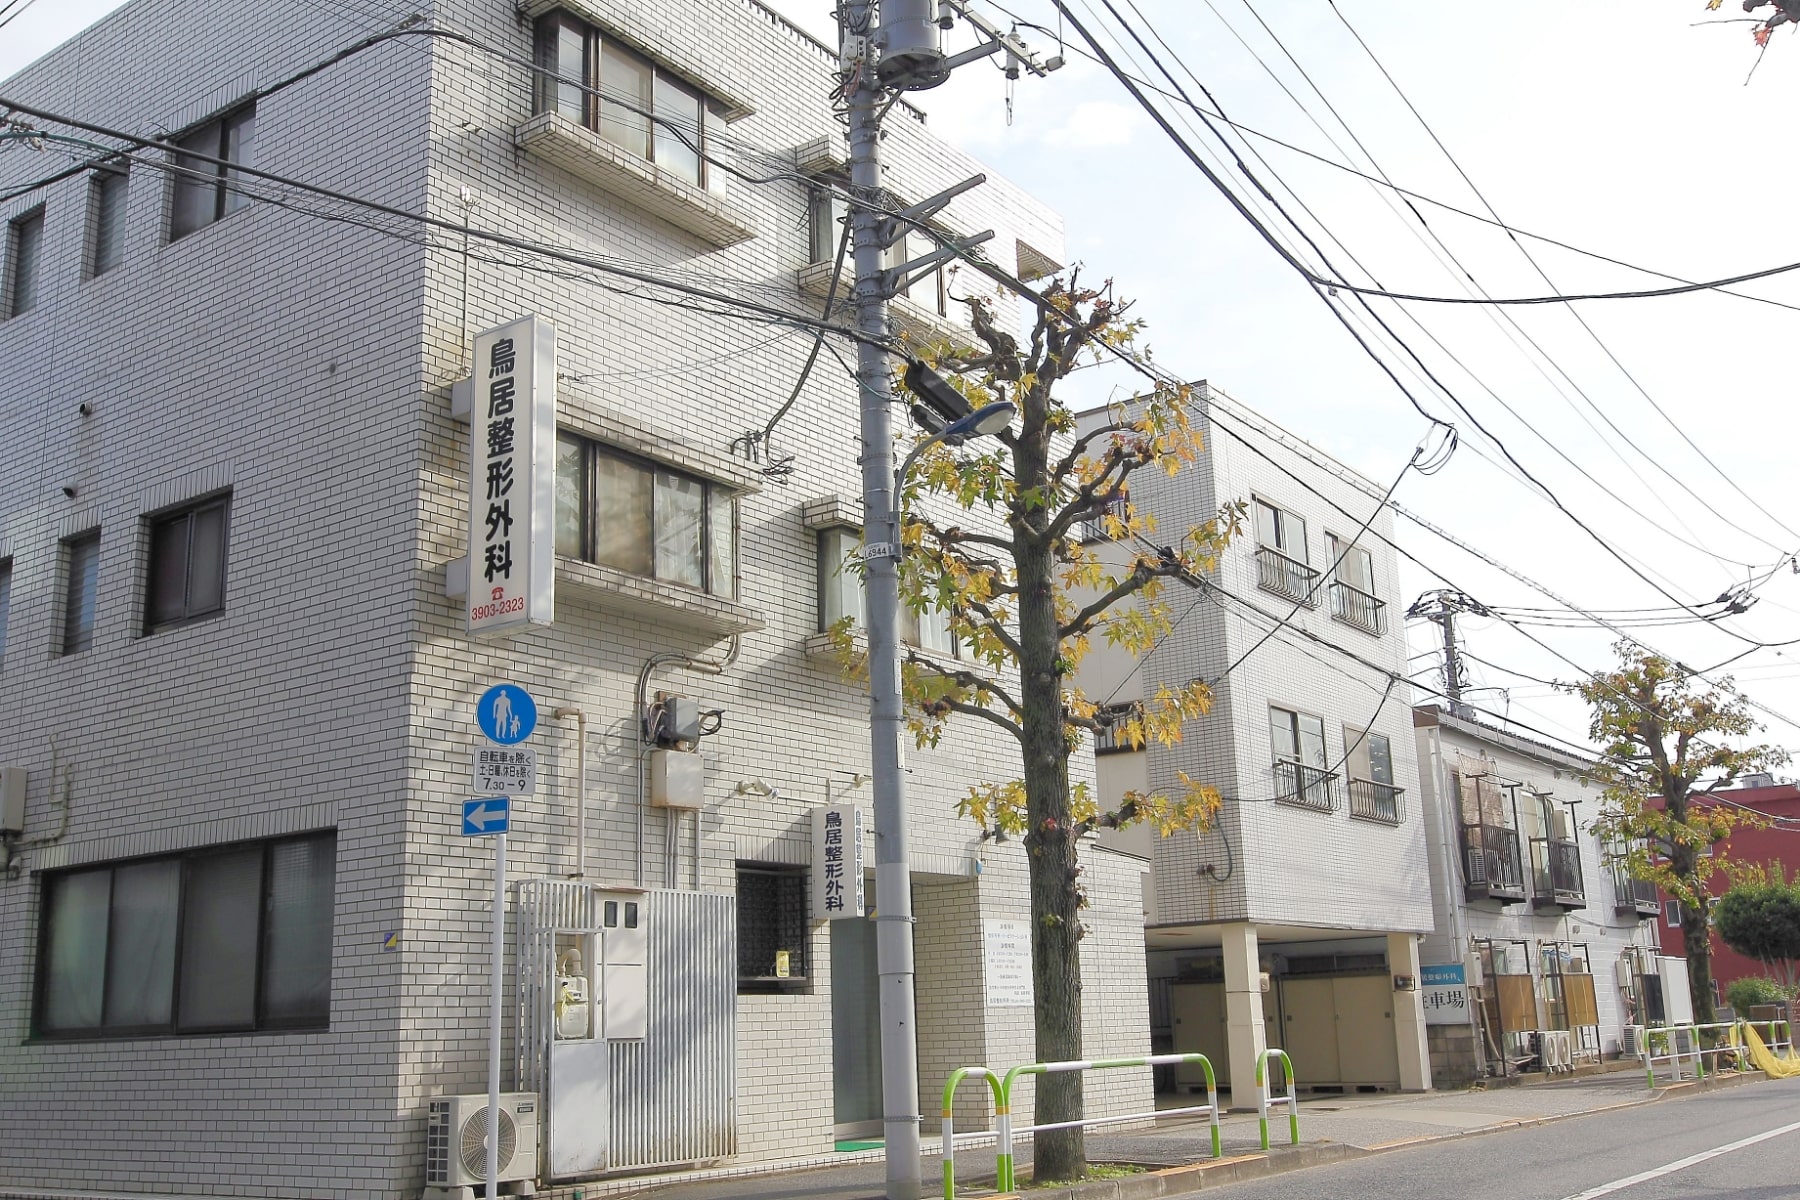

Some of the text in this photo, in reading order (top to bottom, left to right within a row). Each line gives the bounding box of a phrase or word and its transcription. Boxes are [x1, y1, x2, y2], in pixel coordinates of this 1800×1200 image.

[484, 338, 516, 583] 鳥居整形外科
[471, 597, 524, 621] 3903-2323
[479, 750, 531, 764] 自転車を除く
[825, 811, 844, 912] 鳥居整形外科
